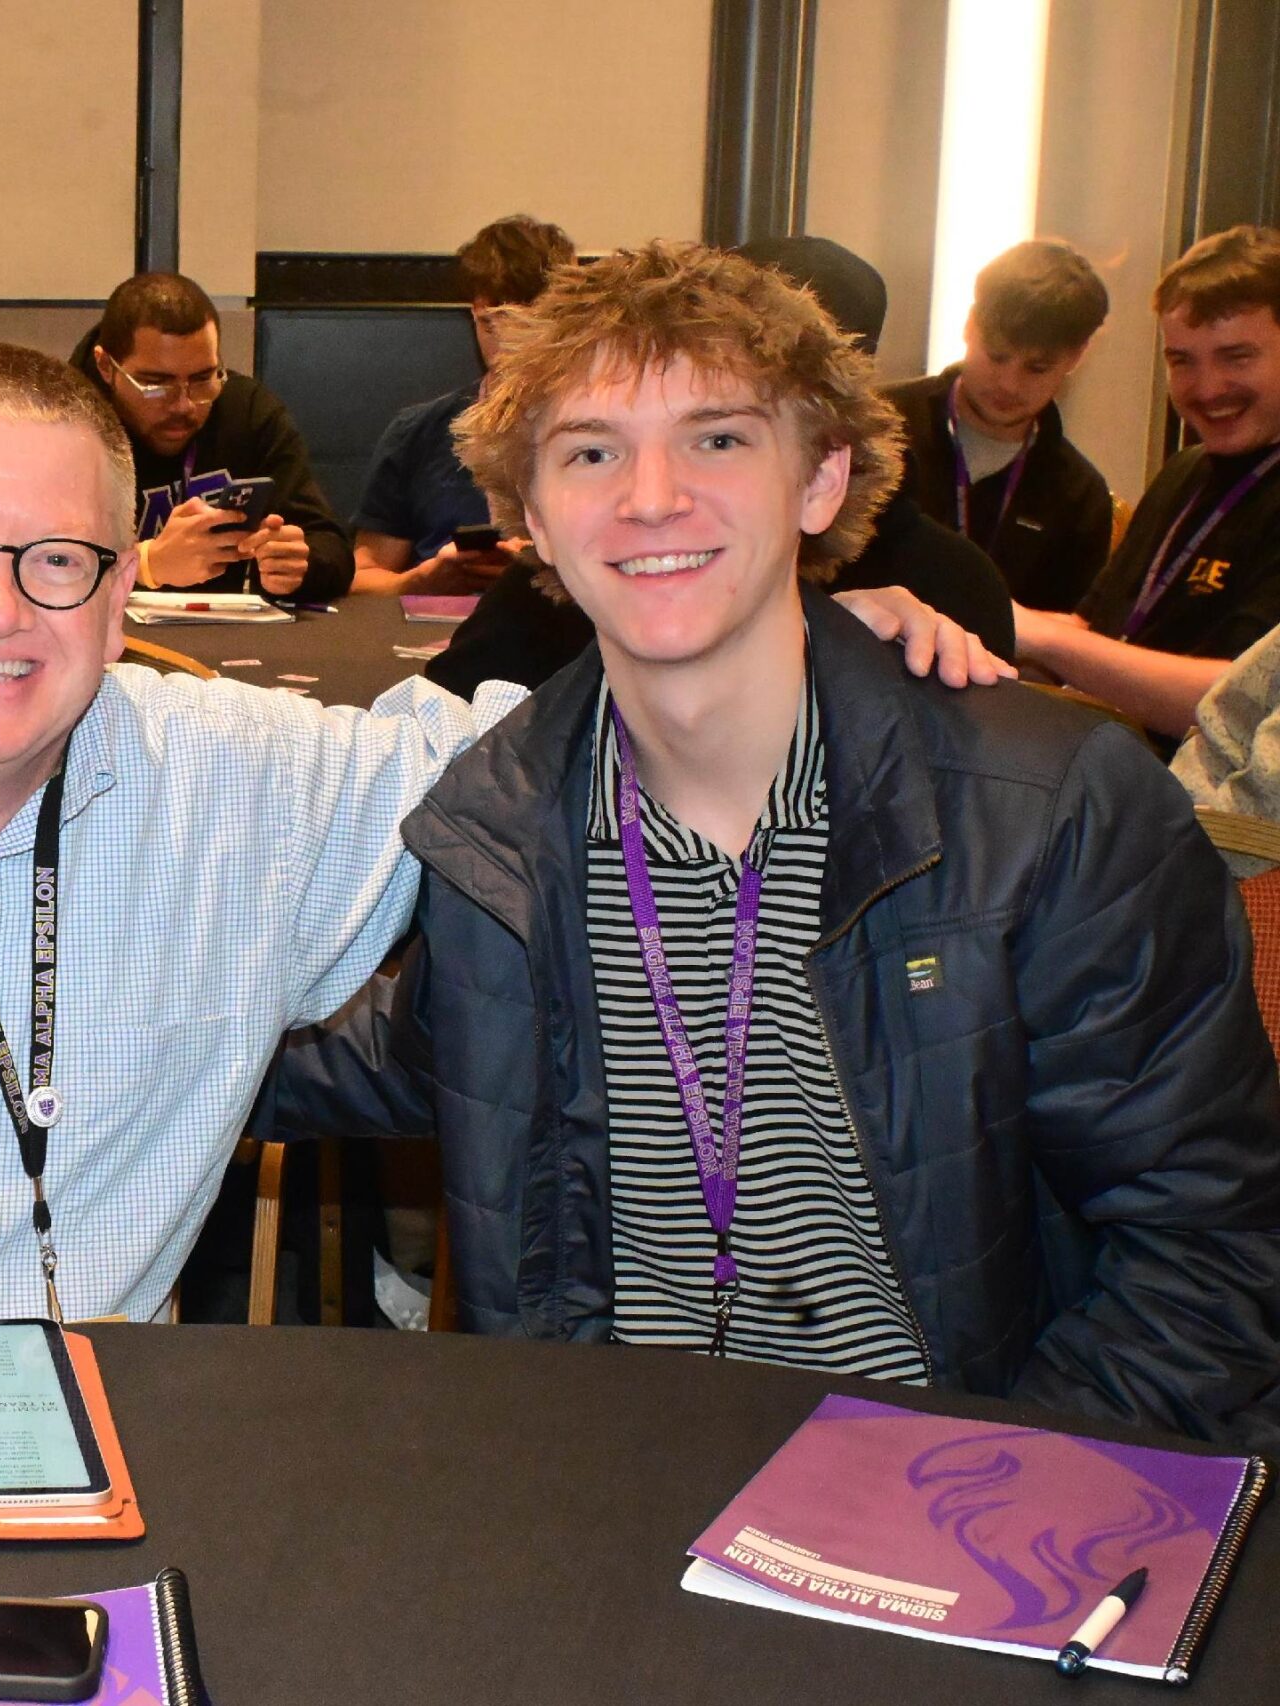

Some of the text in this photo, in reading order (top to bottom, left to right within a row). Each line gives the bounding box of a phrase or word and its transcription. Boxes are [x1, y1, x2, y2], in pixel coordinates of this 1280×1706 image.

[35, 866, 55, 964] EPSILON
[33, 968, 55, 1049] ALPHA
[640, 926, 719, 1180] SIGMA ALPHA EPSILON
[722, 919, 756, 1181] SIGMA ALPHA EPSILON
[723, 1544, 948, 1621] SIGMA ALPHA EPSILON
[731, 1540, 777, 1564] SCHOOL
[777, 1562, 848, 1588] LEADERSHIP
[850, 1585, 909, 1602] NATIONAL
